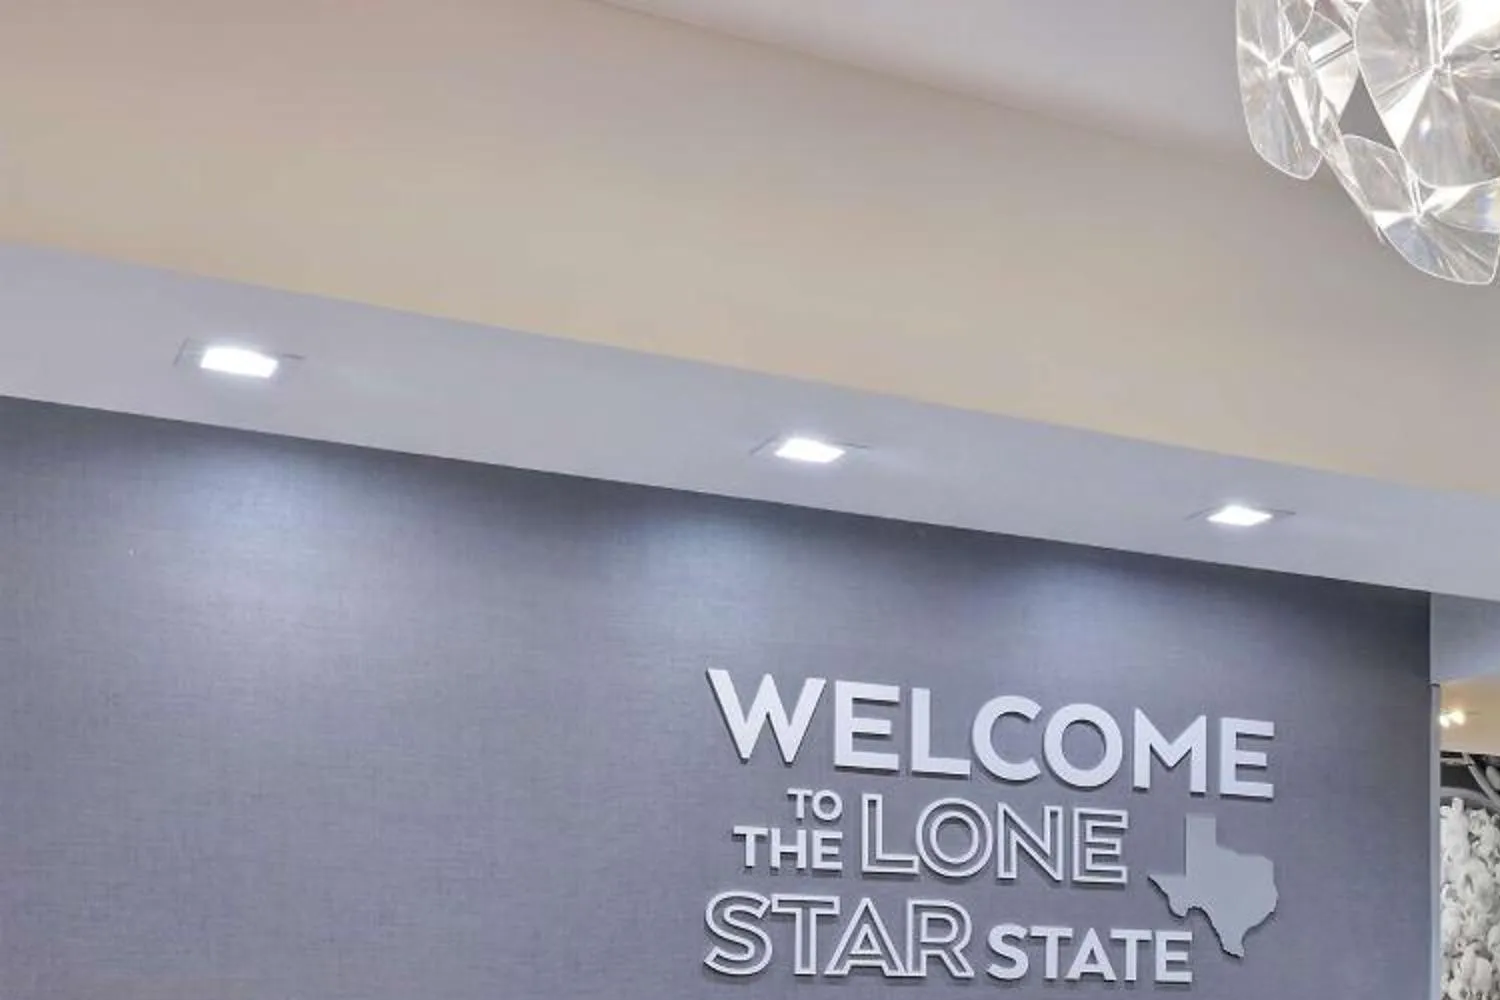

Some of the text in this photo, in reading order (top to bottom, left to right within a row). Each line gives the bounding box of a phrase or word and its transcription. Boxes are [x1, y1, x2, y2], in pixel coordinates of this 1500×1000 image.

[706, 667, 1275, 798] WELCOME
[732, 793, 1128, 884] THE LONE
[787, 788, 843, 821] TO
[703, 891, 1193, 983] STAR STATE
